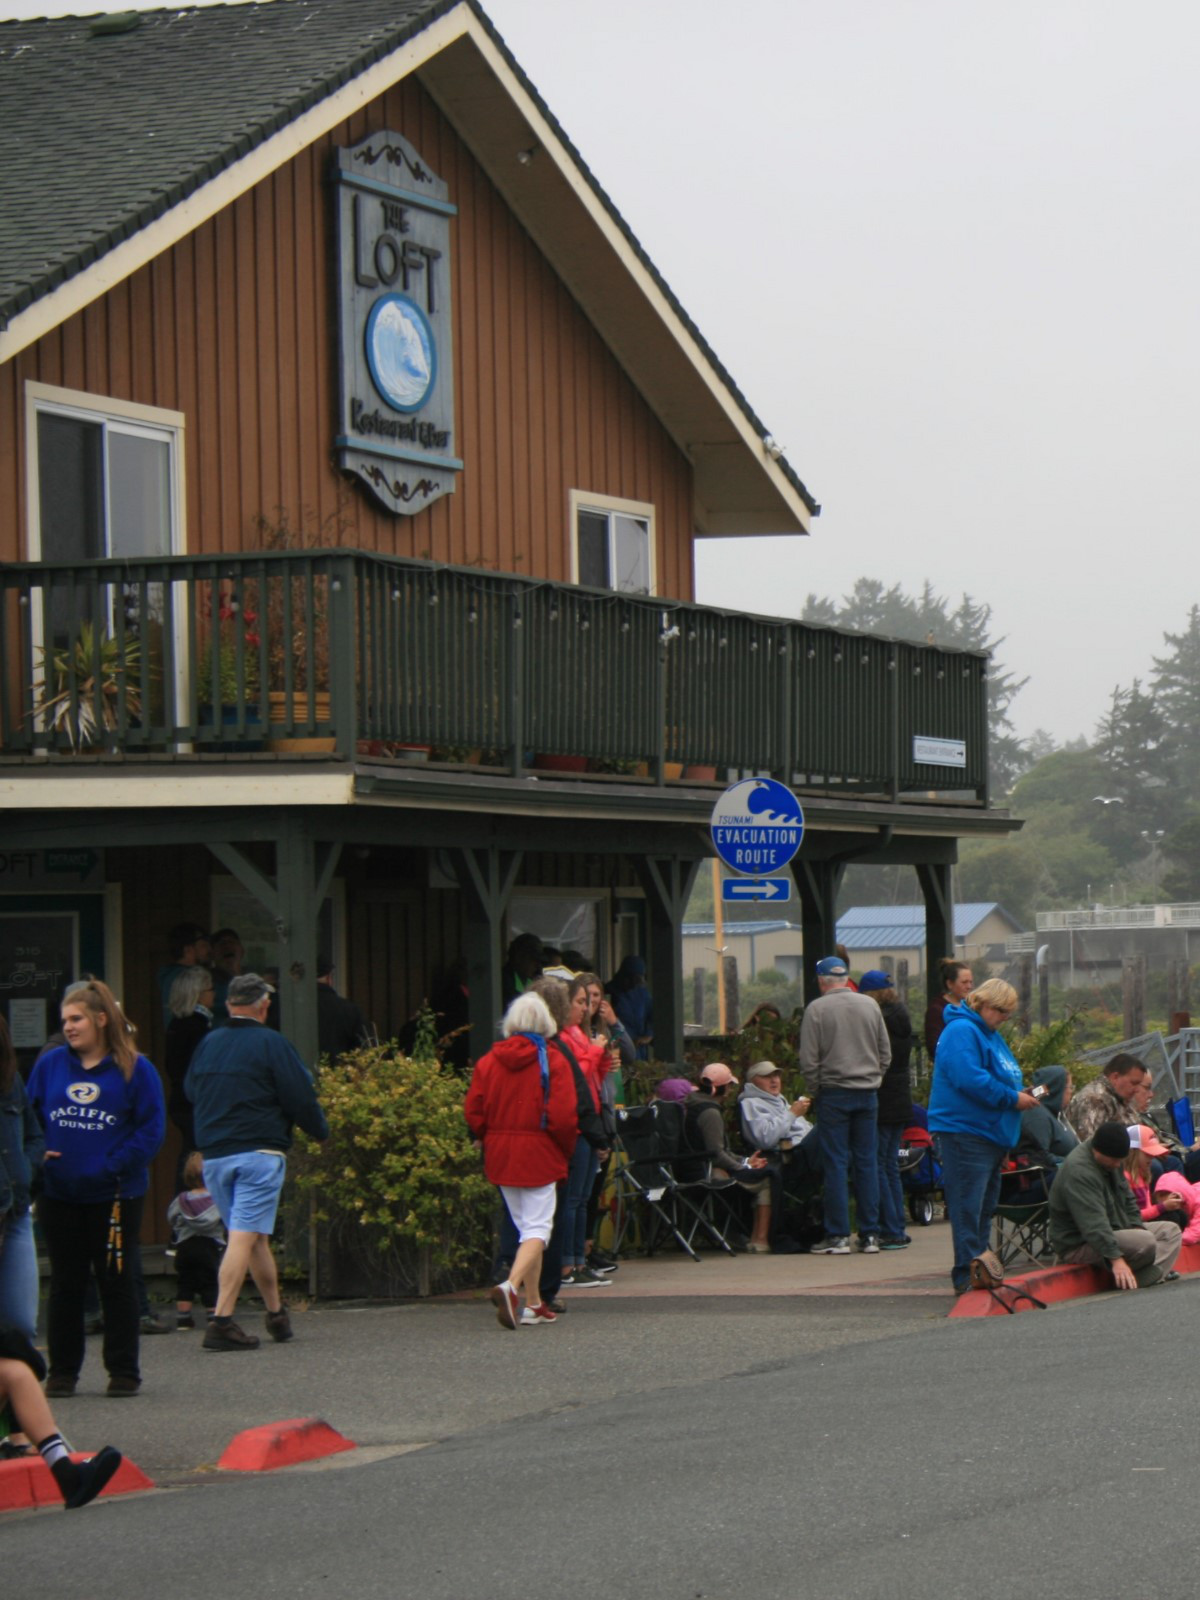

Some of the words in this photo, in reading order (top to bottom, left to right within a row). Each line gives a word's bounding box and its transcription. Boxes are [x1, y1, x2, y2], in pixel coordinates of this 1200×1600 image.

[381, 201, 410, 233] THE
[353, 193, 442, 315] LOFT
[719, 816, 754, 825] TSUNAMI
[717, 829, 797, 844] EVACUATION
[736, 849, 777, 865] ROUTE
[50, 1106, 117, 1126] PACIFIC
[59, 1119, 105, 1131] DUNES
